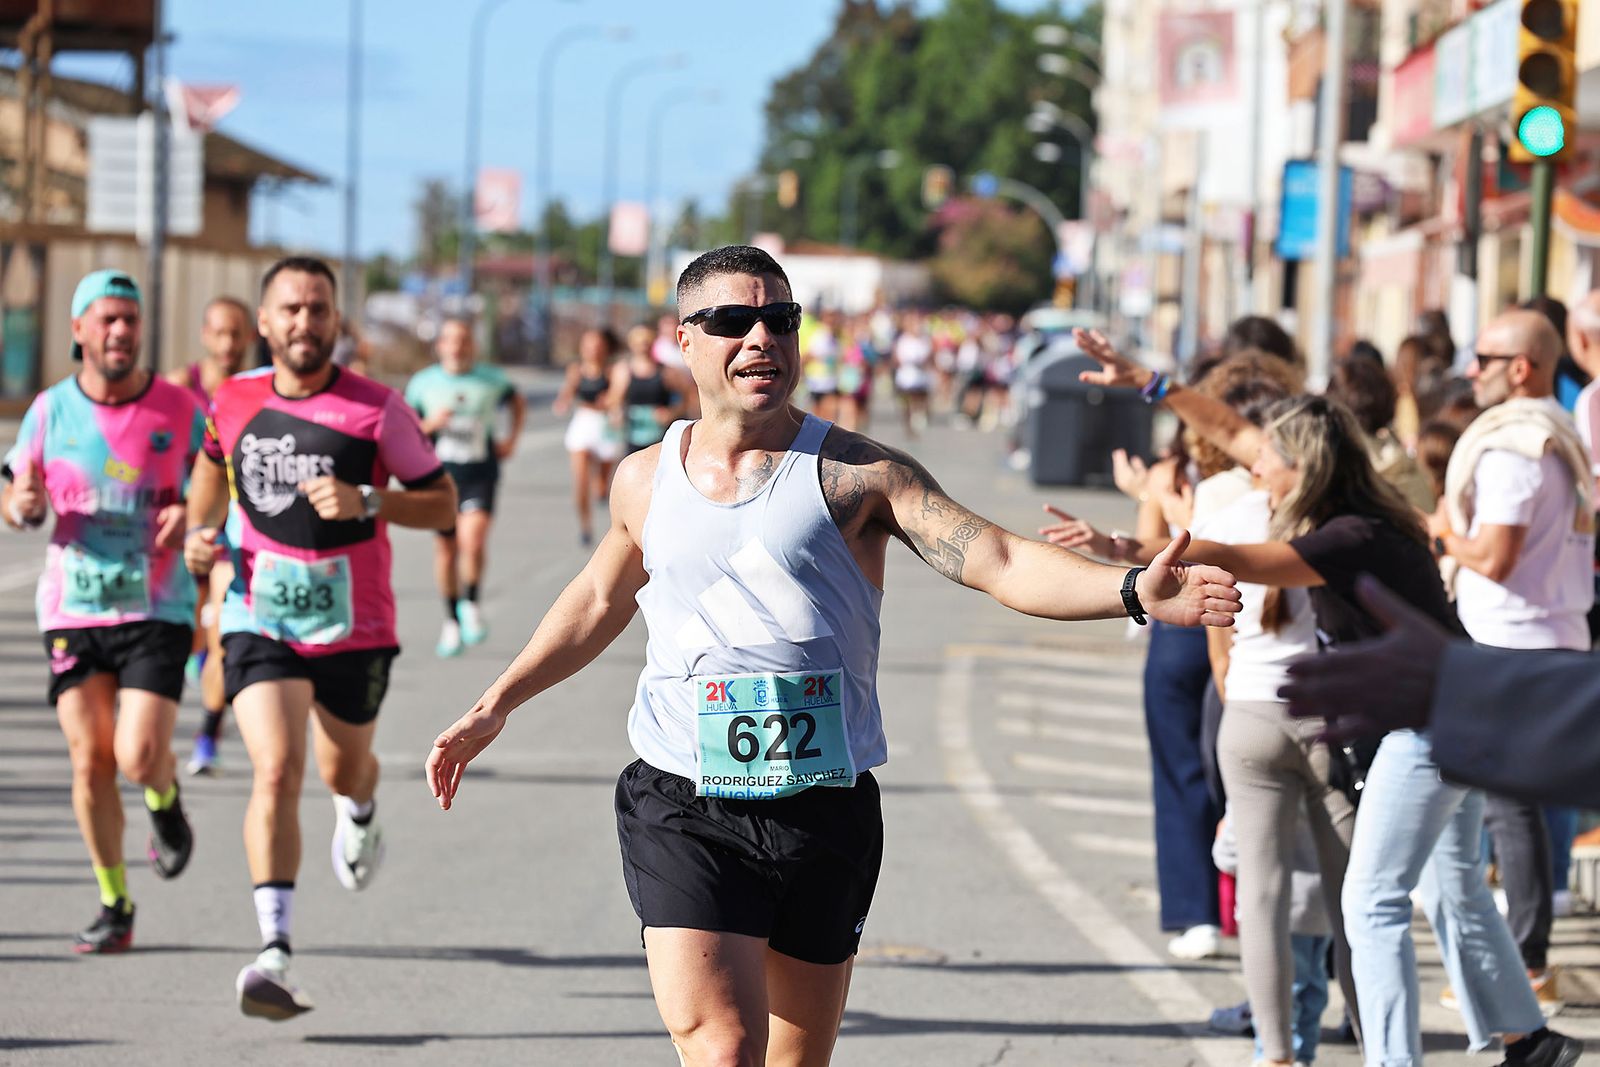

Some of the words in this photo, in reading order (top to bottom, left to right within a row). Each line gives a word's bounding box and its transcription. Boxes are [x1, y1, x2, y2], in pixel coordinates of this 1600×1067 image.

[262, 453, 335, 485] TIGRES
[272, 582, 334, 612] 383
[706, 680, 737, 703] 21K
[804, 675, 834, 697] 21K
[706, 702, 738, 712] HUELVA
[804, 696, 834, 707] HUELVA
[727, 712, 822, 763] 622
[702, 775, 783, 787] RODRIGUEZ
[786, 768, 847, 785] SANCHEZ
